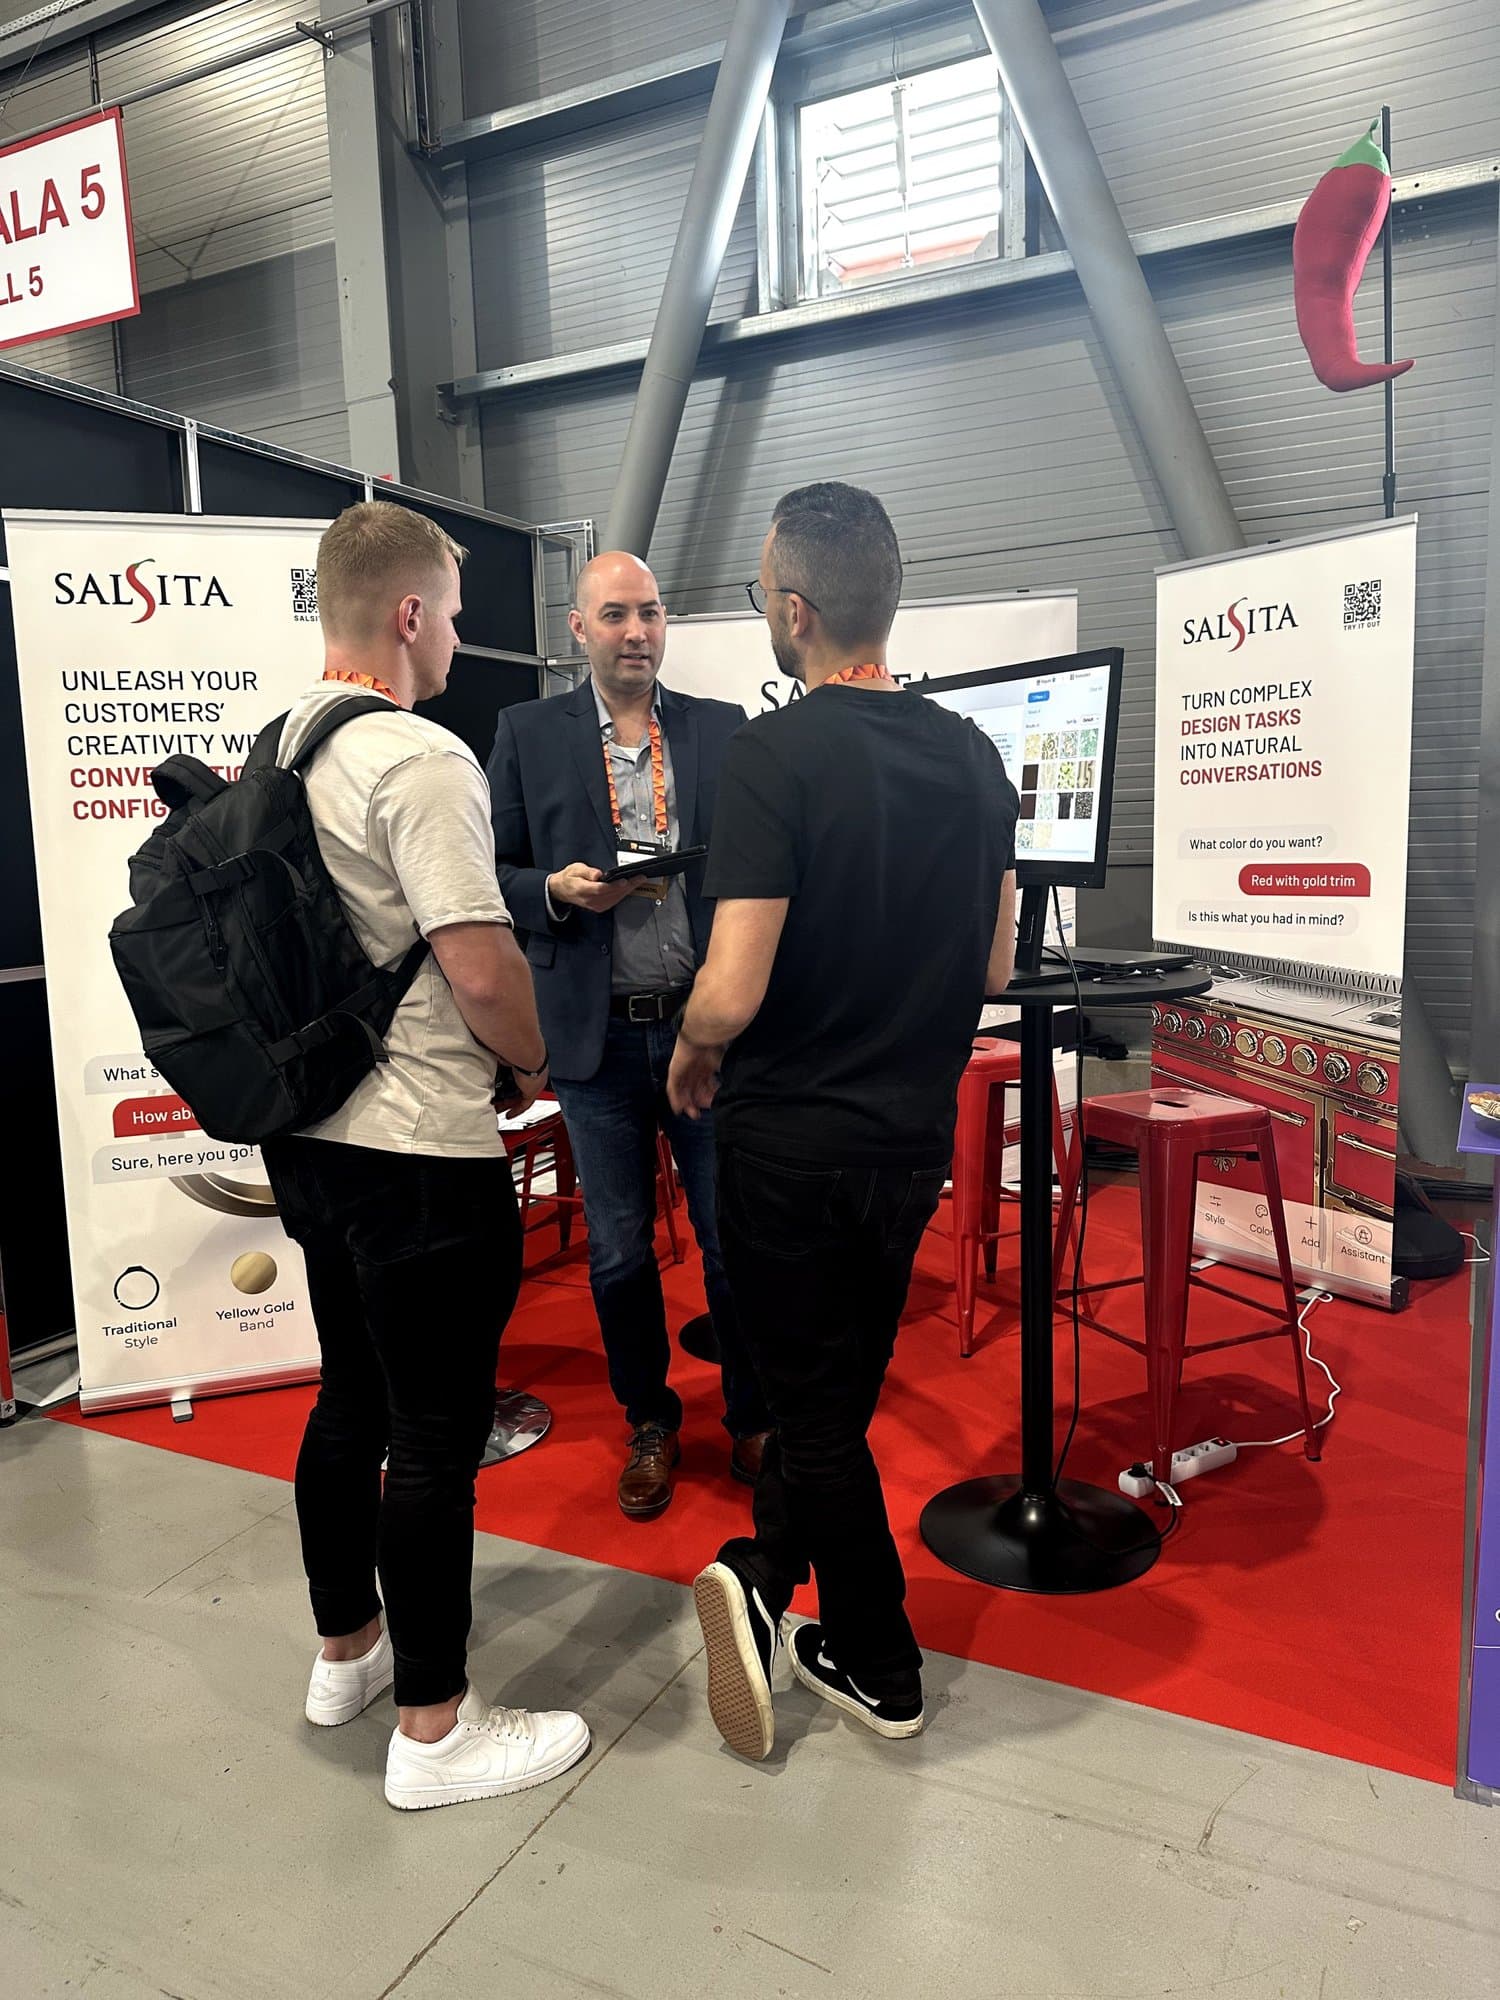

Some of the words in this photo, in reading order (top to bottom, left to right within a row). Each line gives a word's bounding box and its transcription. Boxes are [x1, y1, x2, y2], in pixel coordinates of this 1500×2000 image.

[80, 163, 106, 220] 5
[0, 272, 24, 306] L
[28, 265, 44, 297] 5
[54, 558, 234, 624] SALSITA
[1183, 596, 1299, 653] SALSITA
[1367, 620, 1380, 628] OUT
[62, 670, 184, 691] UNLEASH
[190, 670, 258, 691] YOUR
[1181, 690, 1225, 711] TURN
[1230, 679, 1313, 706] COMPLEX
[1181, 714, 1241, 737] DESIGN
[1244, 708, 1301, 730] TASKS
[68, 734, 214, 756] CREATIVITY
[221, 734, 258, 753] WI
[1181, 742, 1217, 761] INTO
[1221, 735, 1303, 758] NATURAL
[1180, 760, 1322, 785] CONVERSATIONS
[73, 798, 171, 820] CONFIG
[1189, 839, 1217, 850] What
[1219, 838, 1248, 850] color
[1249, 837, 1264, 849] do
[1265, 839, 1286, 852] you
[1288, 835, 1323, 848] want?
[1251, 874, 1273, 887] Red
[1274, 874, 1300, 887] with
[1302, 874, 1328, 890] gold
[1329, 874, 1356, 887] trim
[1188, 911, 1198, 922] Is
[1199, 911, 1220, 923] this
[1221, 911, 1249, 923] what
[1250, 914, 1270, 926] you
[1272, 912, 1293, 925] had
[1295, 913, 1306, 925] in
[1308, 913, 1345, 926] mind?
[103, 1066, 147, 1082] What
[132, 1110, 168, 1125] How
[172, 1107, 194, 1121] ab
[111, 1157, 153, 1171] Sure,
[157, 1153, 194, 1167] here
[197, 1150, 225, 1166] you
[230, 1145, 254, 1161] go!
[1205, 1213, 1225, 1225] Style
[1301, 1236, 1320, 1248] Add
[1341, 1246, 1385, 1264] Assistant
[216, 1306, 260, 1321] Yellow
[263, 1300, 295, 1314] Gold
[102, 1317, 177, 1336] Traditional
[239, 1318, 274, 1333] Band
[124, 1334, 158, 1349] Style
